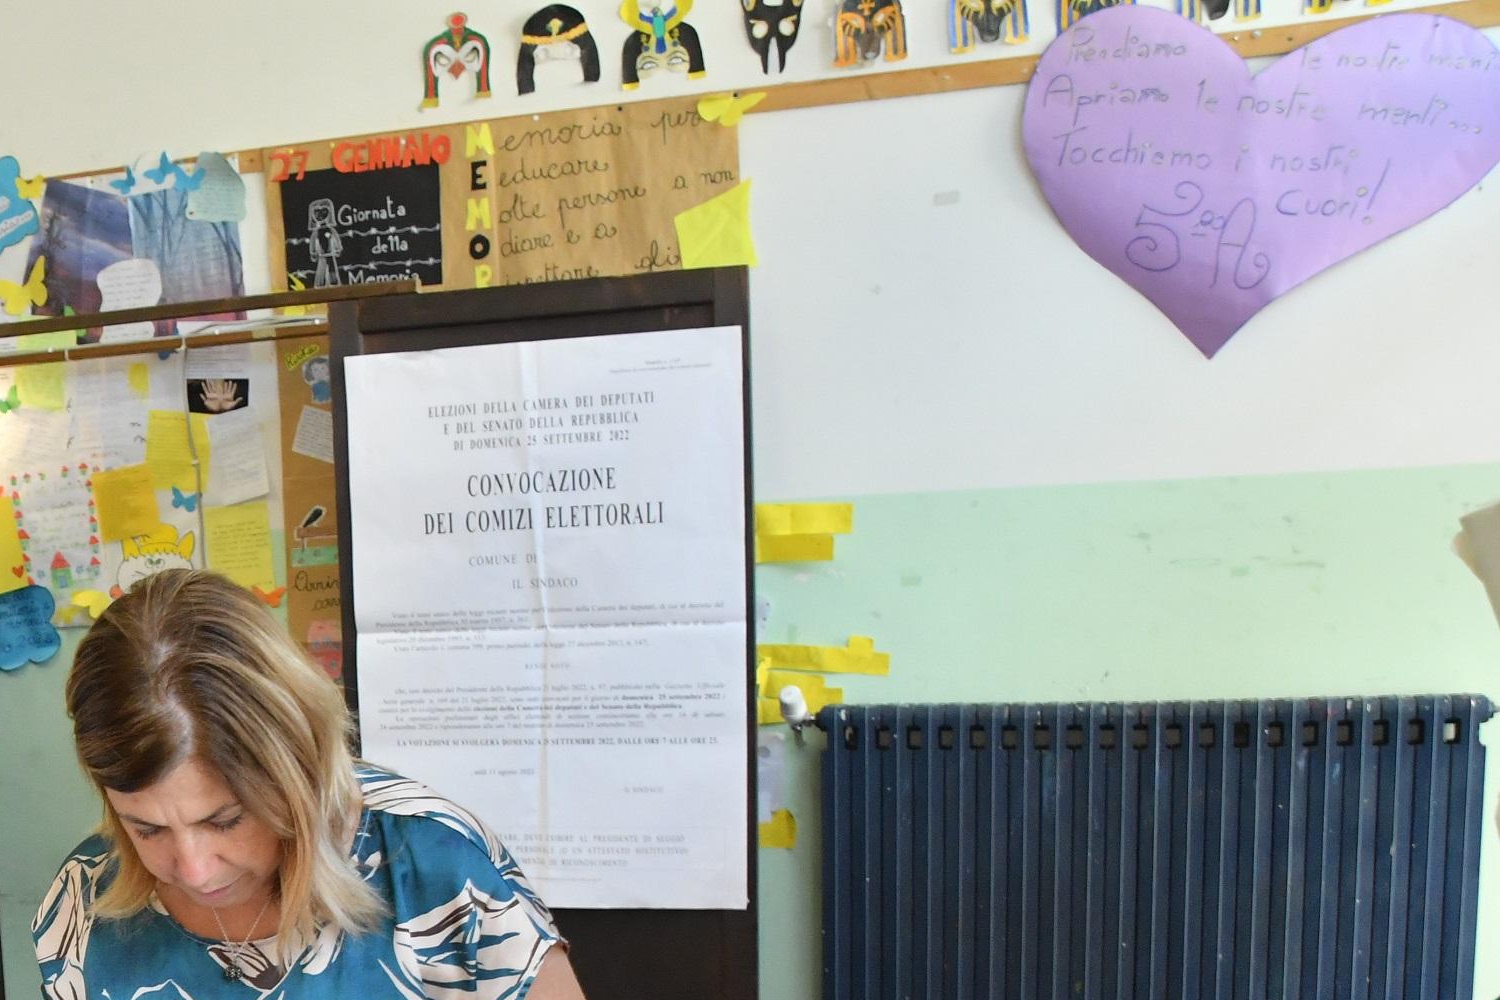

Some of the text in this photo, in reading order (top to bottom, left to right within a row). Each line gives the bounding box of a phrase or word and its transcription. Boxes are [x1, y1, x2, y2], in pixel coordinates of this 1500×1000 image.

[1043, 73, 1170, 128] Apriamo
[331, 132, 451, 174] GENNAIO
[702, 166, 735, 186] non
[337, 195, 407, 226] Giornata
[371, 236, 409, 255] della
[428, 390, 655, 419] ELEZIONI DELLA CAMERA DEI DEPUTATI
[456, 421, 476, 434] DEL
[482, 418, 523, 434] SENATO
[529, 415, 564, 430] DELLA
[571, 411, 639, 428] REPUBBLICA
[470, 436, 522, 452] DOMENICA
[542, 431, 602, 447] SETTEMBRE
[467, 467, 617, 498] CONVOCAZIONE
[424, 501, 665, 536] DEI COMIZI ELETTORALI
[468, 553, 518, 568] COMUNE
[530, 576, 579, 590] SINDACO
